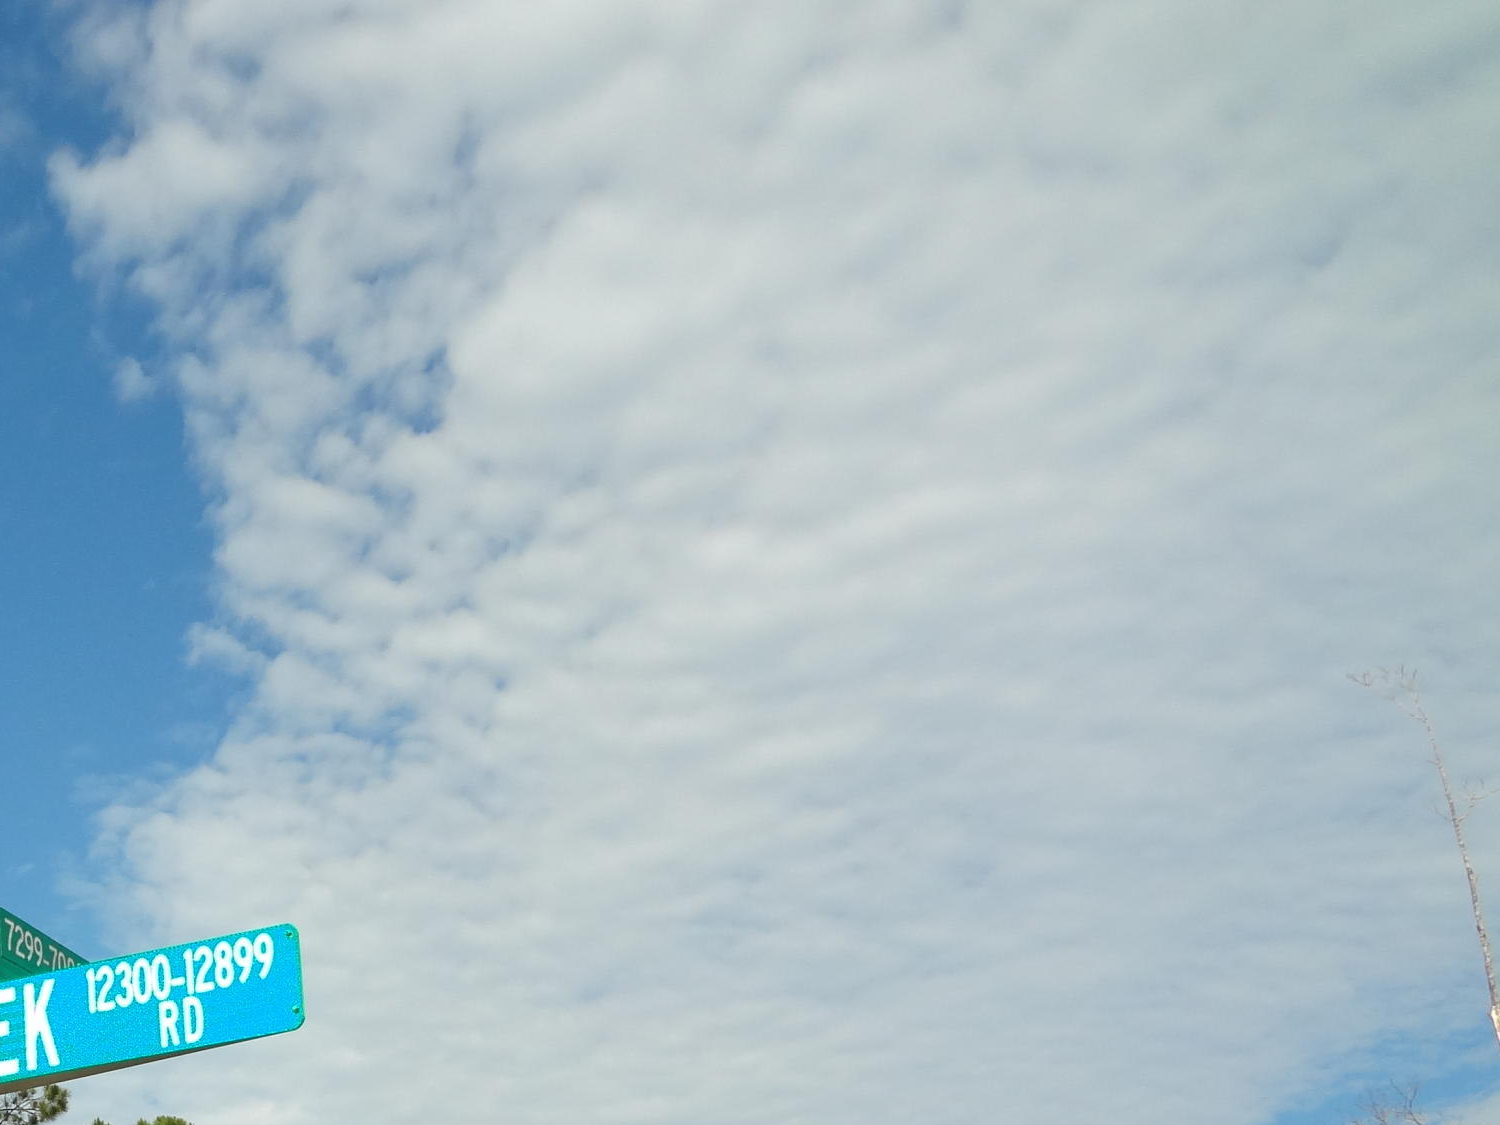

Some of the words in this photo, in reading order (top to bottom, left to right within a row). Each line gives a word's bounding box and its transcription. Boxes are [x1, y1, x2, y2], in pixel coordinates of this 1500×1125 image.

[4, 917, 81, 971] 7299-70
[87, 932, 275, 1013] 12300-12899
[159, 996, 205, 1048] RD
